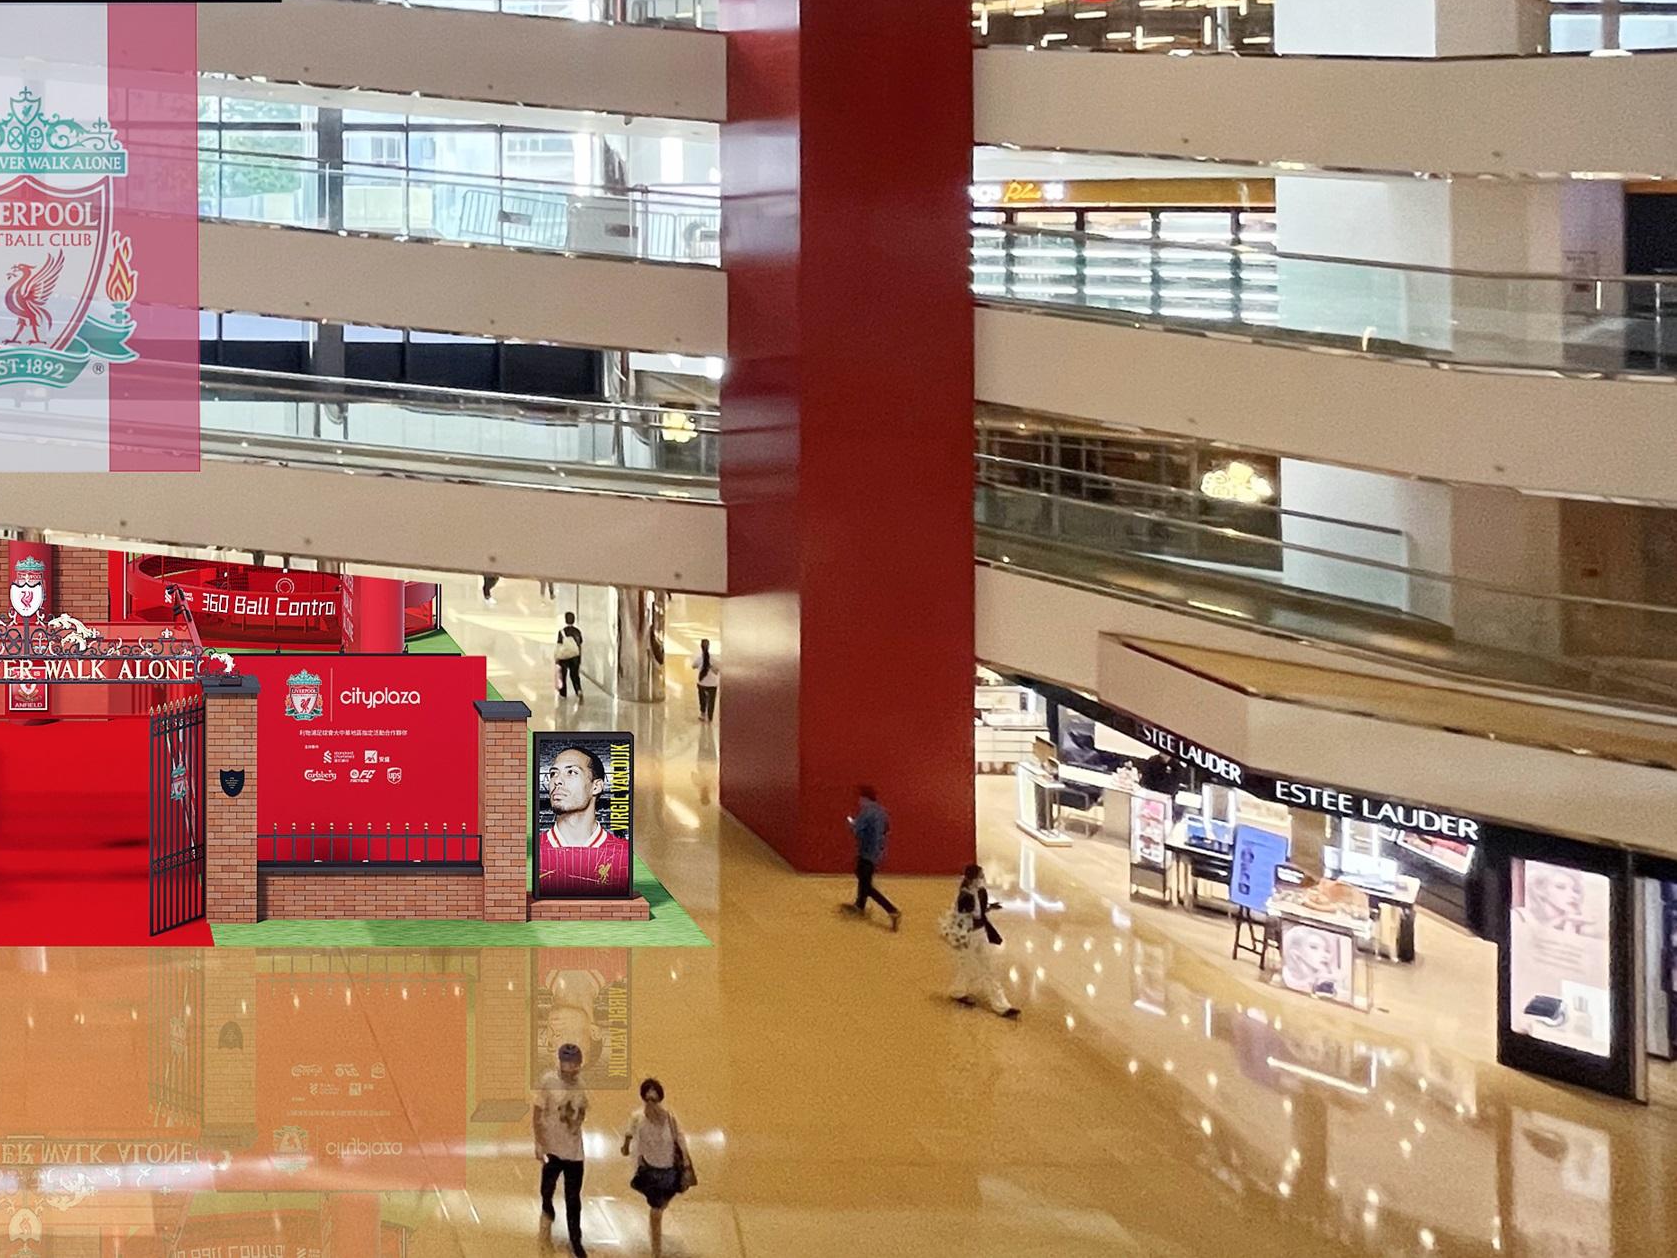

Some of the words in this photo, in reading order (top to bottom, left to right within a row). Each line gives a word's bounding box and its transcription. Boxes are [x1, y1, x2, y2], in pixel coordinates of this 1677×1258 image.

[27, 156, 71, 170] WALK
[72, 156, 121, 170] ALONE
[49, 233, 92, 247] CLUB
[201, 593, 229, 614] 360
[234, 595, 270, 615] Ball
[44, 659, 104, 681] WALK
[118, 659, 195, 681] ALONE
[340, 687, 421, 709] cityplaza
[610, 744, 630, 767] DIJK
[1179, 740, 1241, 784] LAUDER
[304, 769, 337, 782] Carlsberg
[610, 771, 630, 793] VAN
[610, 793, 630, 831] VIRGIL
[1275, 780, 1353, 814] ESTEE
[1362, 798, 1479, 840] LAUDER
